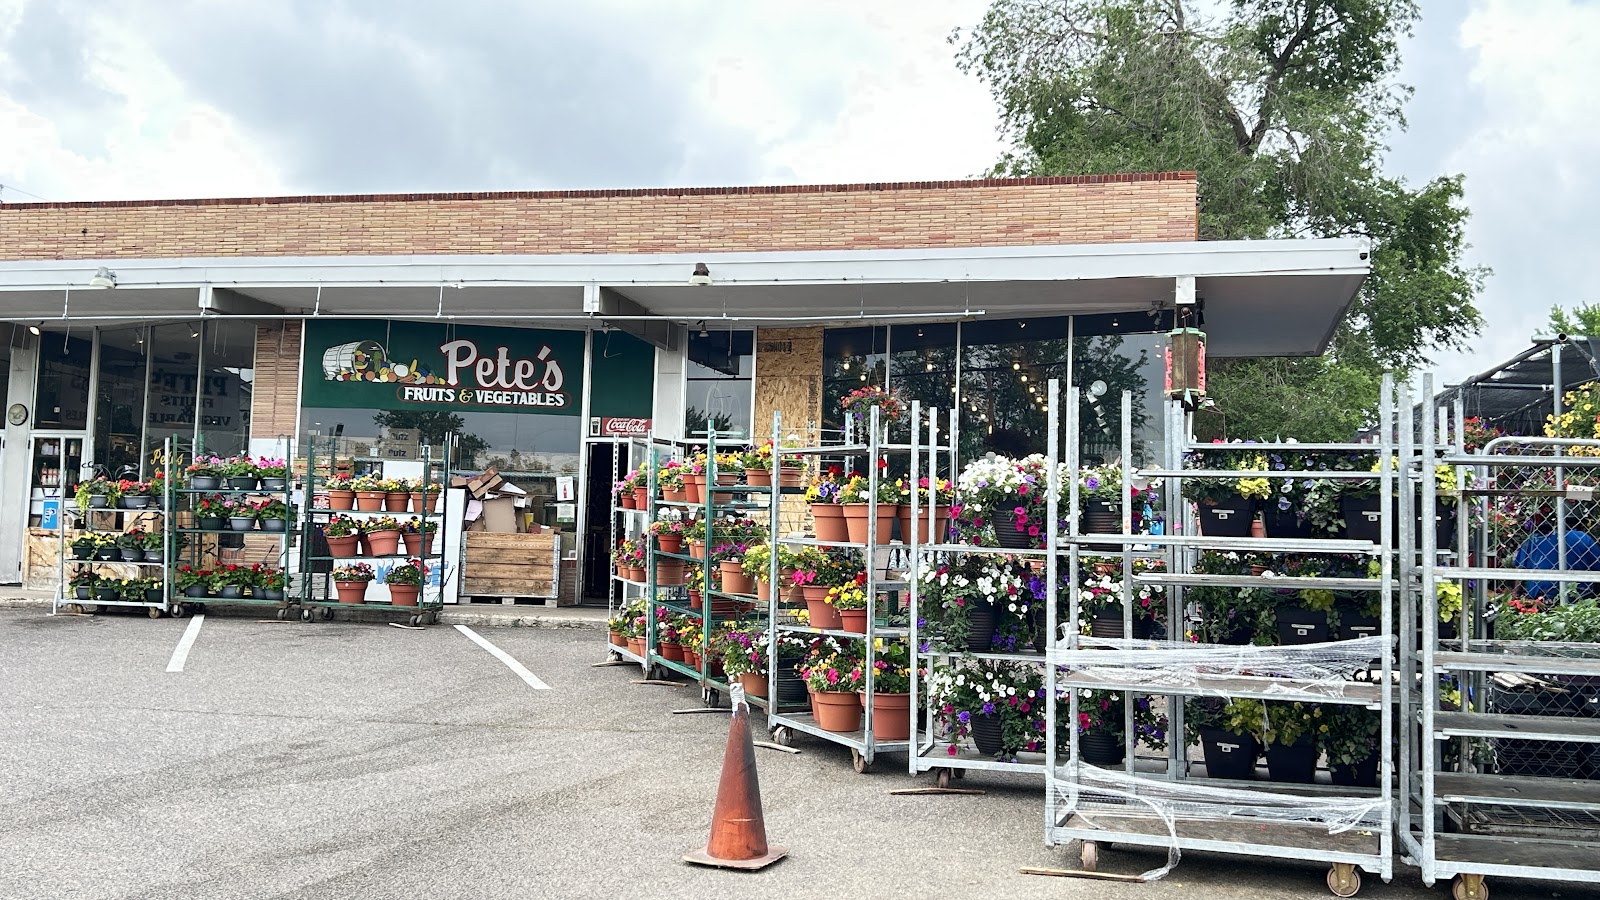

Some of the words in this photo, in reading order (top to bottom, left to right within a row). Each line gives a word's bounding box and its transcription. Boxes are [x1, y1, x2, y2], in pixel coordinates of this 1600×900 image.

[440, 339, 564, 392] Pete's
[404, 386, 455, 402] FRUITS
[459, 388, 474, 403] &
[474, 389, 565, 407] VEGETABLES
